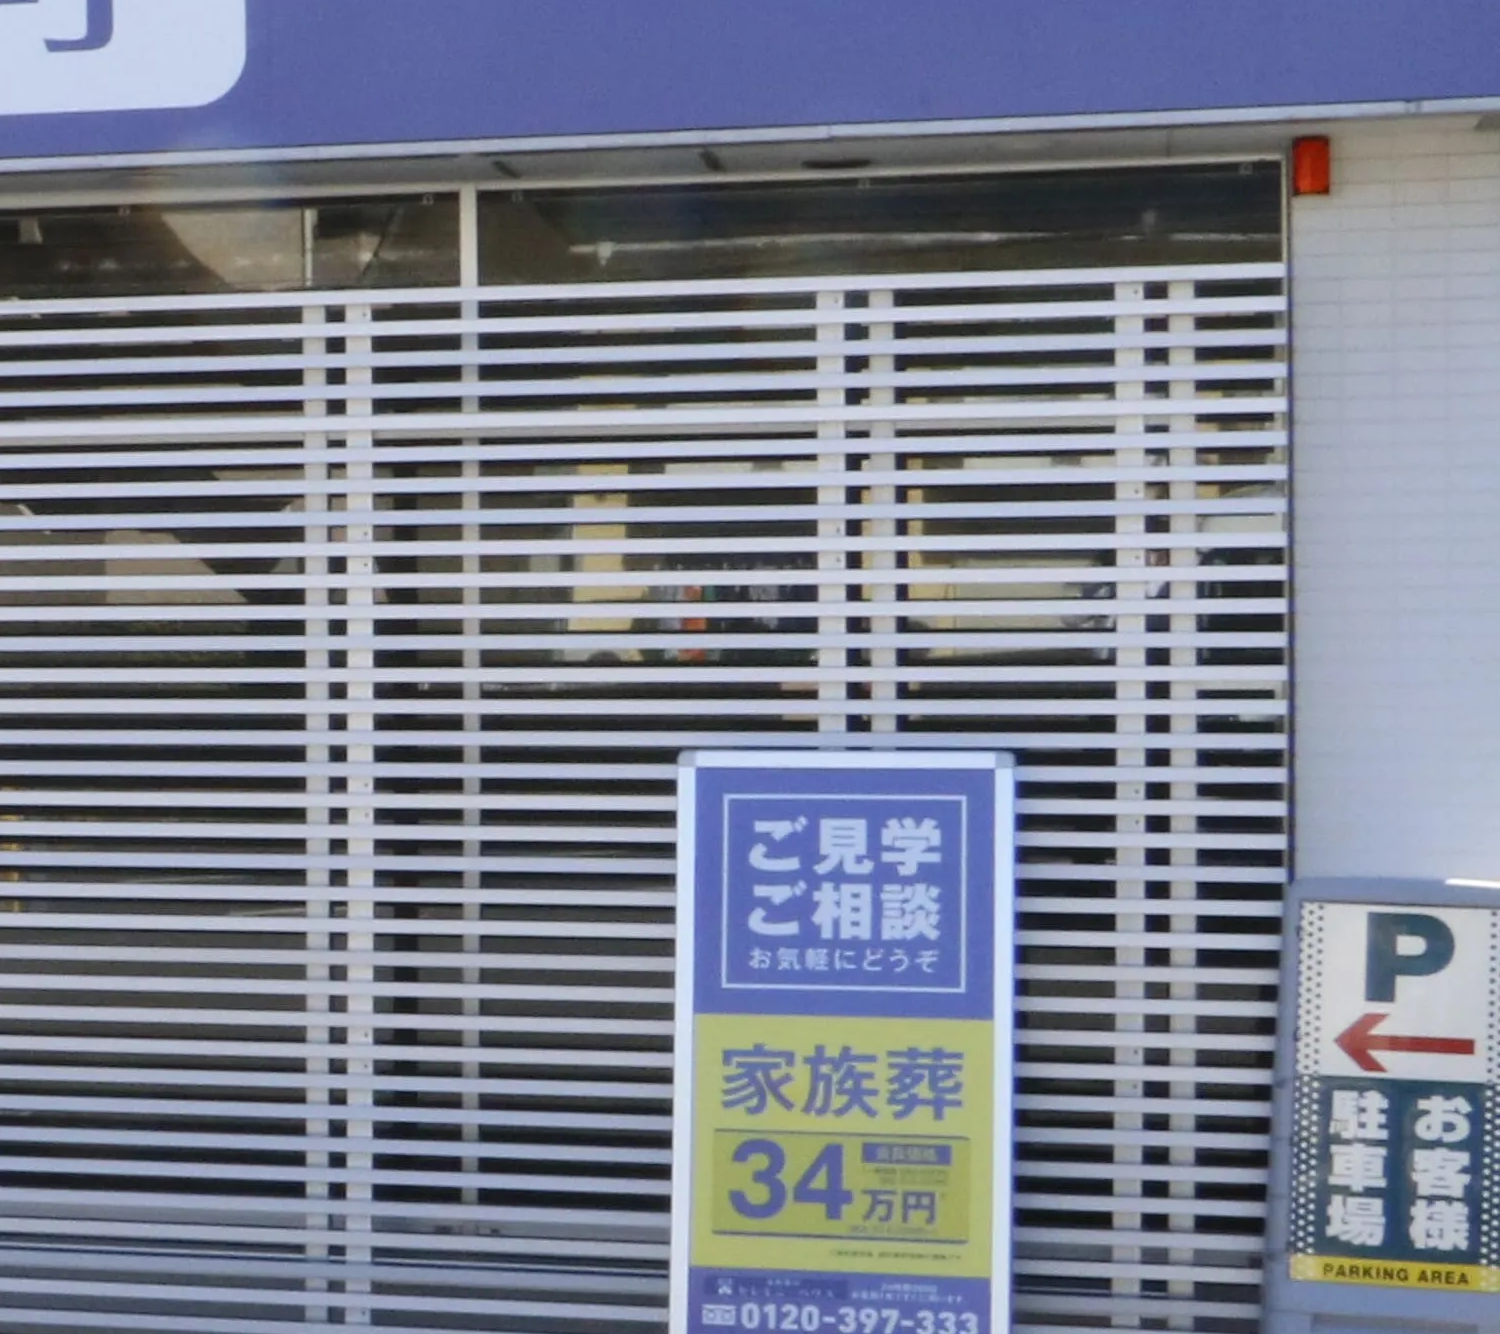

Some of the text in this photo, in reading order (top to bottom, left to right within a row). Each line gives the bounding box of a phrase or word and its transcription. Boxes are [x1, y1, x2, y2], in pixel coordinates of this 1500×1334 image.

[748, 815, 942, 876] ご見学
[748, 880, 942, 940] ご相談
[749, 947, 939, 973] お気軽にどうぞ
[1364, 911, 1456, 1002] P
[721, 1043, 965, 1121] 家族葬
[1324, 1089, 1390, 1248] 駐車場
[1409, 1095, 1472, 1251] お客様
[1322, 1262, 1470, 1286] PARKING AREA
